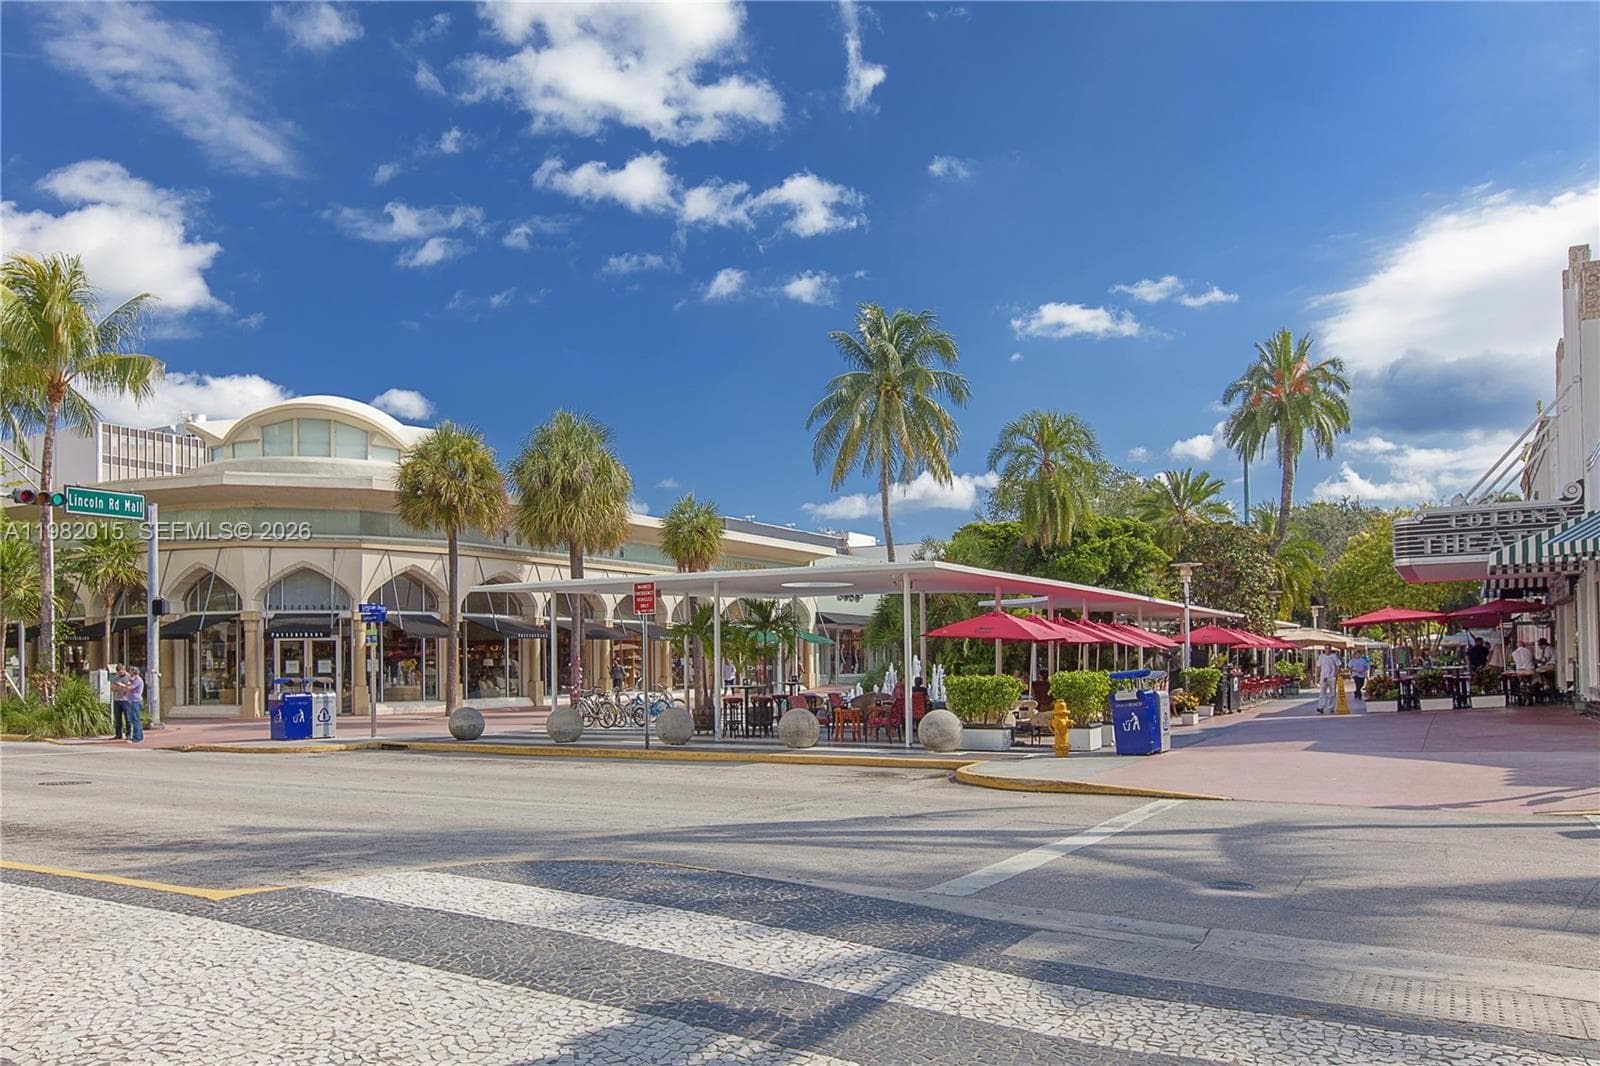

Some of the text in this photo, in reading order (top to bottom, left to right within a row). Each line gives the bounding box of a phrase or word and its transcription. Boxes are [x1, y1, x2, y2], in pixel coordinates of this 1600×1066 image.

[68, 493, 143, 513] Lincoln Rd Mall
[1418, 528, 1533, 555] THEAT
